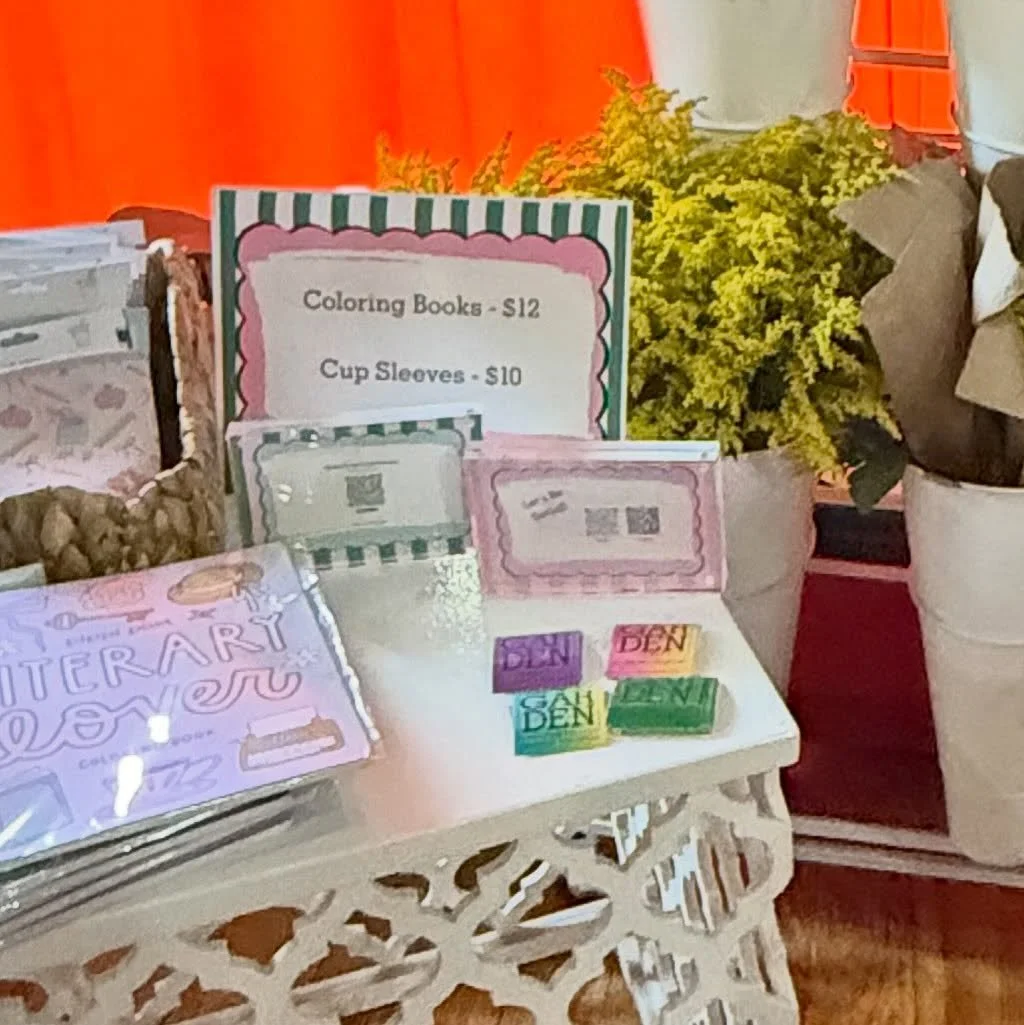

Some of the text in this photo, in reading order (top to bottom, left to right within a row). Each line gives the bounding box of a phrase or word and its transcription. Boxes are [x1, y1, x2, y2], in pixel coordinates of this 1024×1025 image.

[303, 289, 406, 318] Coloring
[413, 293, 482, 317] Books
[502, 297, 540, 319] $12
[319, 357, 370, 385] Cup
[375, 360, 465, 384] Sleeves
[485, 365, 522, 387] $10
[523, 704, 593, 732] DEN
